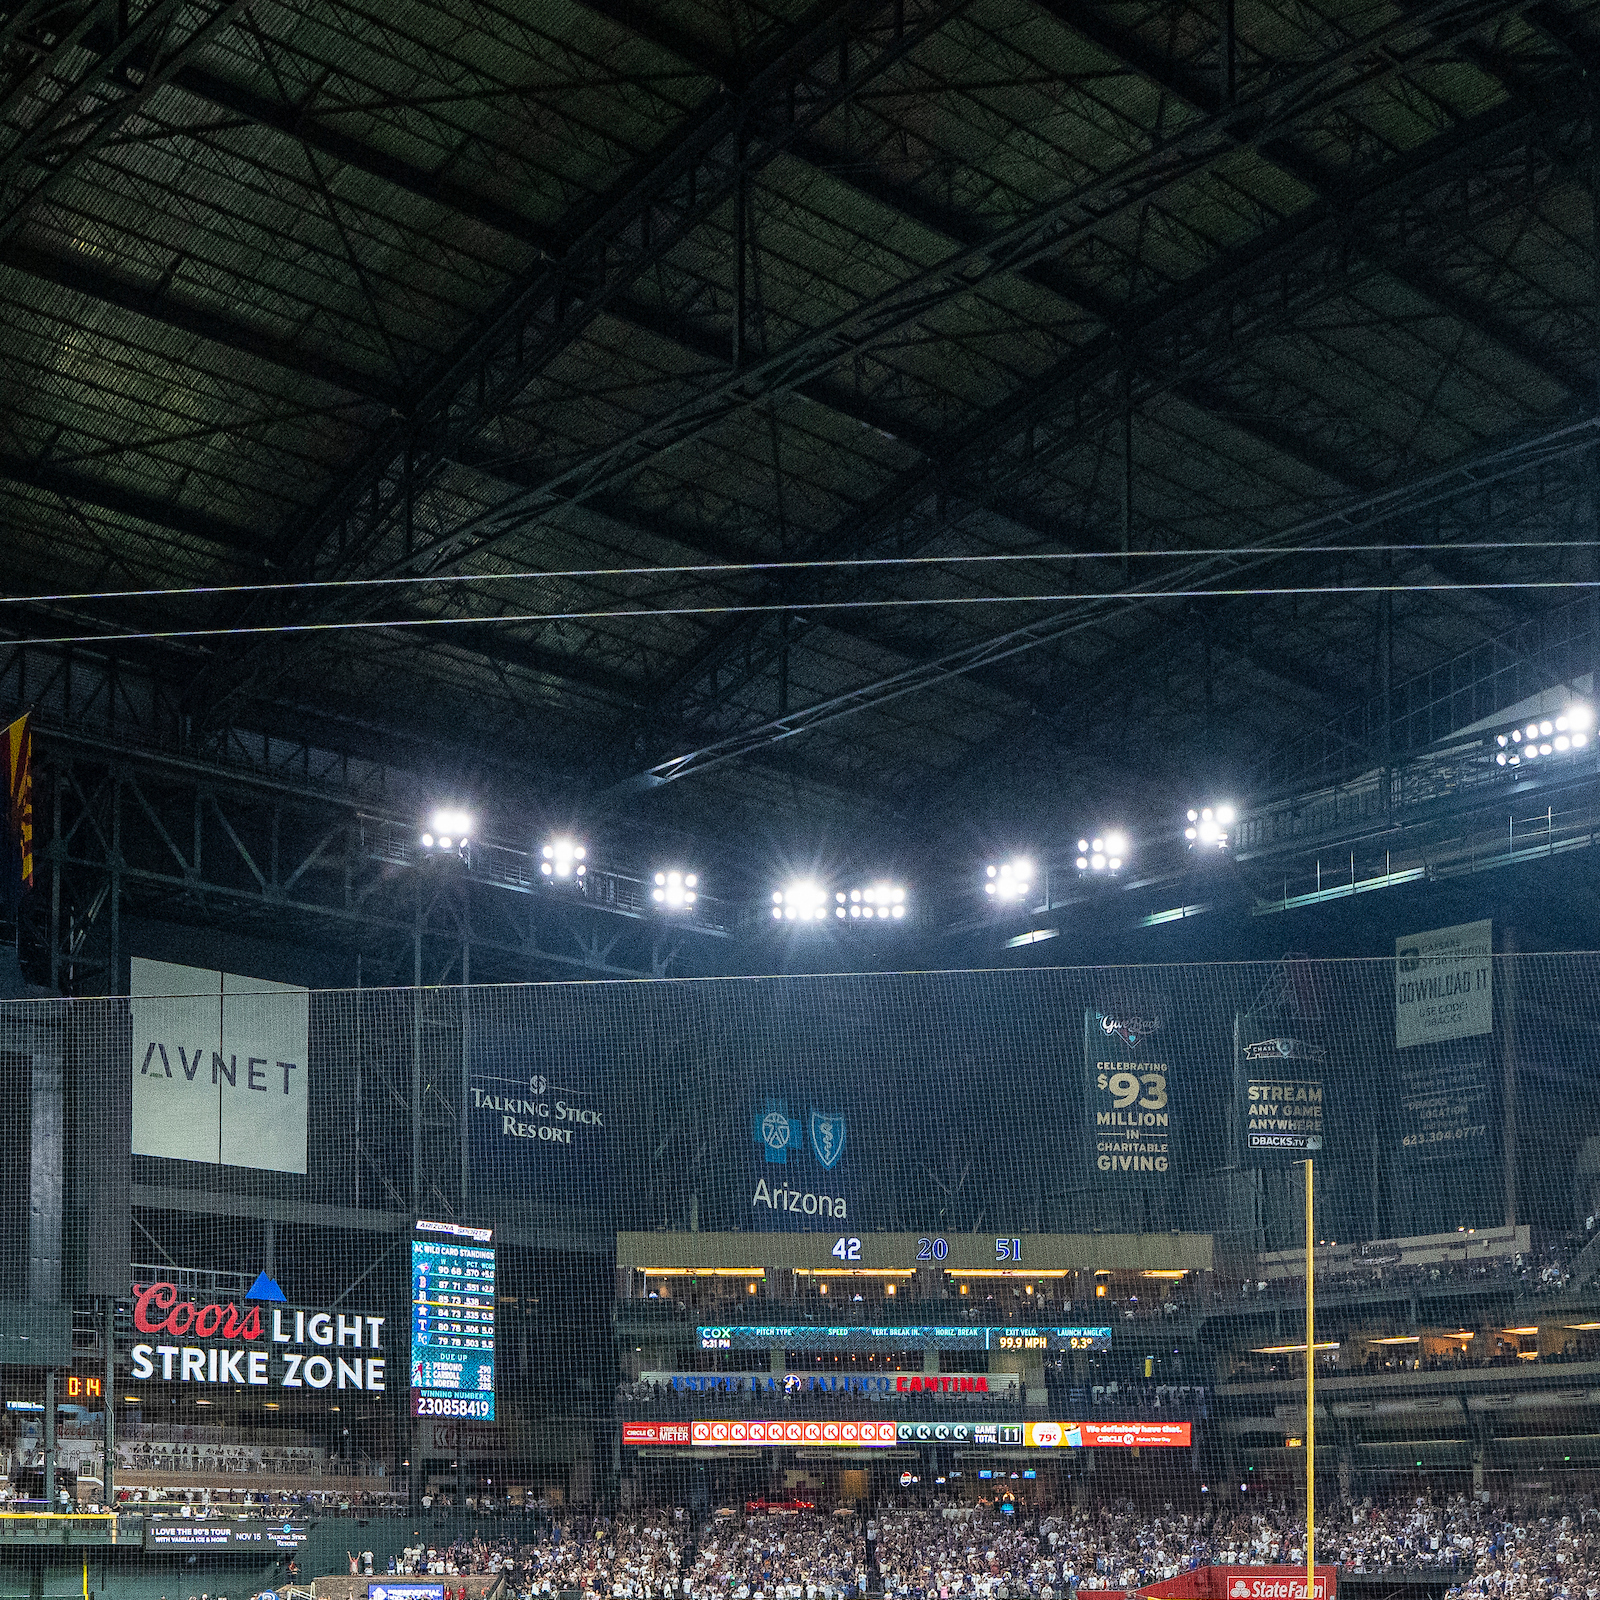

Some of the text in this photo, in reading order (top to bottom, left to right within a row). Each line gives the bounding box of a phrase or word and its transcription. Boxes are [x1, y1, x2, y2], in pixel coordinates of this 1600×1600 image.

[140, 1042, 297, 1095] AVNET
[1097, 1061, 1167, 1071] CELEBRATING
[1097, 1073, 1168, 1110] $93
[1248, 1086, 1323, 1102] STREAM
[470, 1087, 604, 1127] TALKING STICK
[1248, 1104, 1322, 1117] ANY GAME
[1097, 1112, 1169, 1127] MILLION
[1248, 1119, 1322, 1130] ANYWHERE
[502, 1115, 574, 1144] RESORT
[1126, 1129, 1140, 1140] IN
[1097, 1142, 1168, 1153] CHARITABLE
[1097, 1155, 1168, 1171] GIVING
[753, 1178, 847, 1220] Arizona
[424, 1245, 495, 1260] WILD CARD STANDINGS
[831, 1237, 861, 1260] 42
[916, 1237, 949, 1261] 20
[995, 1238, 1022, 1260] 51
[132, 1282, 386, 1349] Coors LIGHT
[702, 1328, 731, 1338] COX
[756, 1328, 792, 1336] PITCH TYPE
[1057, 1329, 1081, 1337] LAUNCH
[702, 1339, 731, 1348] 9:31 PM
[1000, 1337, 1047, 1348] 99.9 MPH
[132, 1344, 386, 1391] STRIKE ZONE
[68, 1377, 100, 1398] 0:14
[897, 1376, 988, 1392] CANTINA
[421, 1390, 484, 1400] WINNING NUMBER
[418, 1398, 489, 1416] 230858419
[975, 1425, 997, 1434] GAME
[659, 1433, 689, 1442] METER
[975, 1434, 997, 1443] TOTAL
